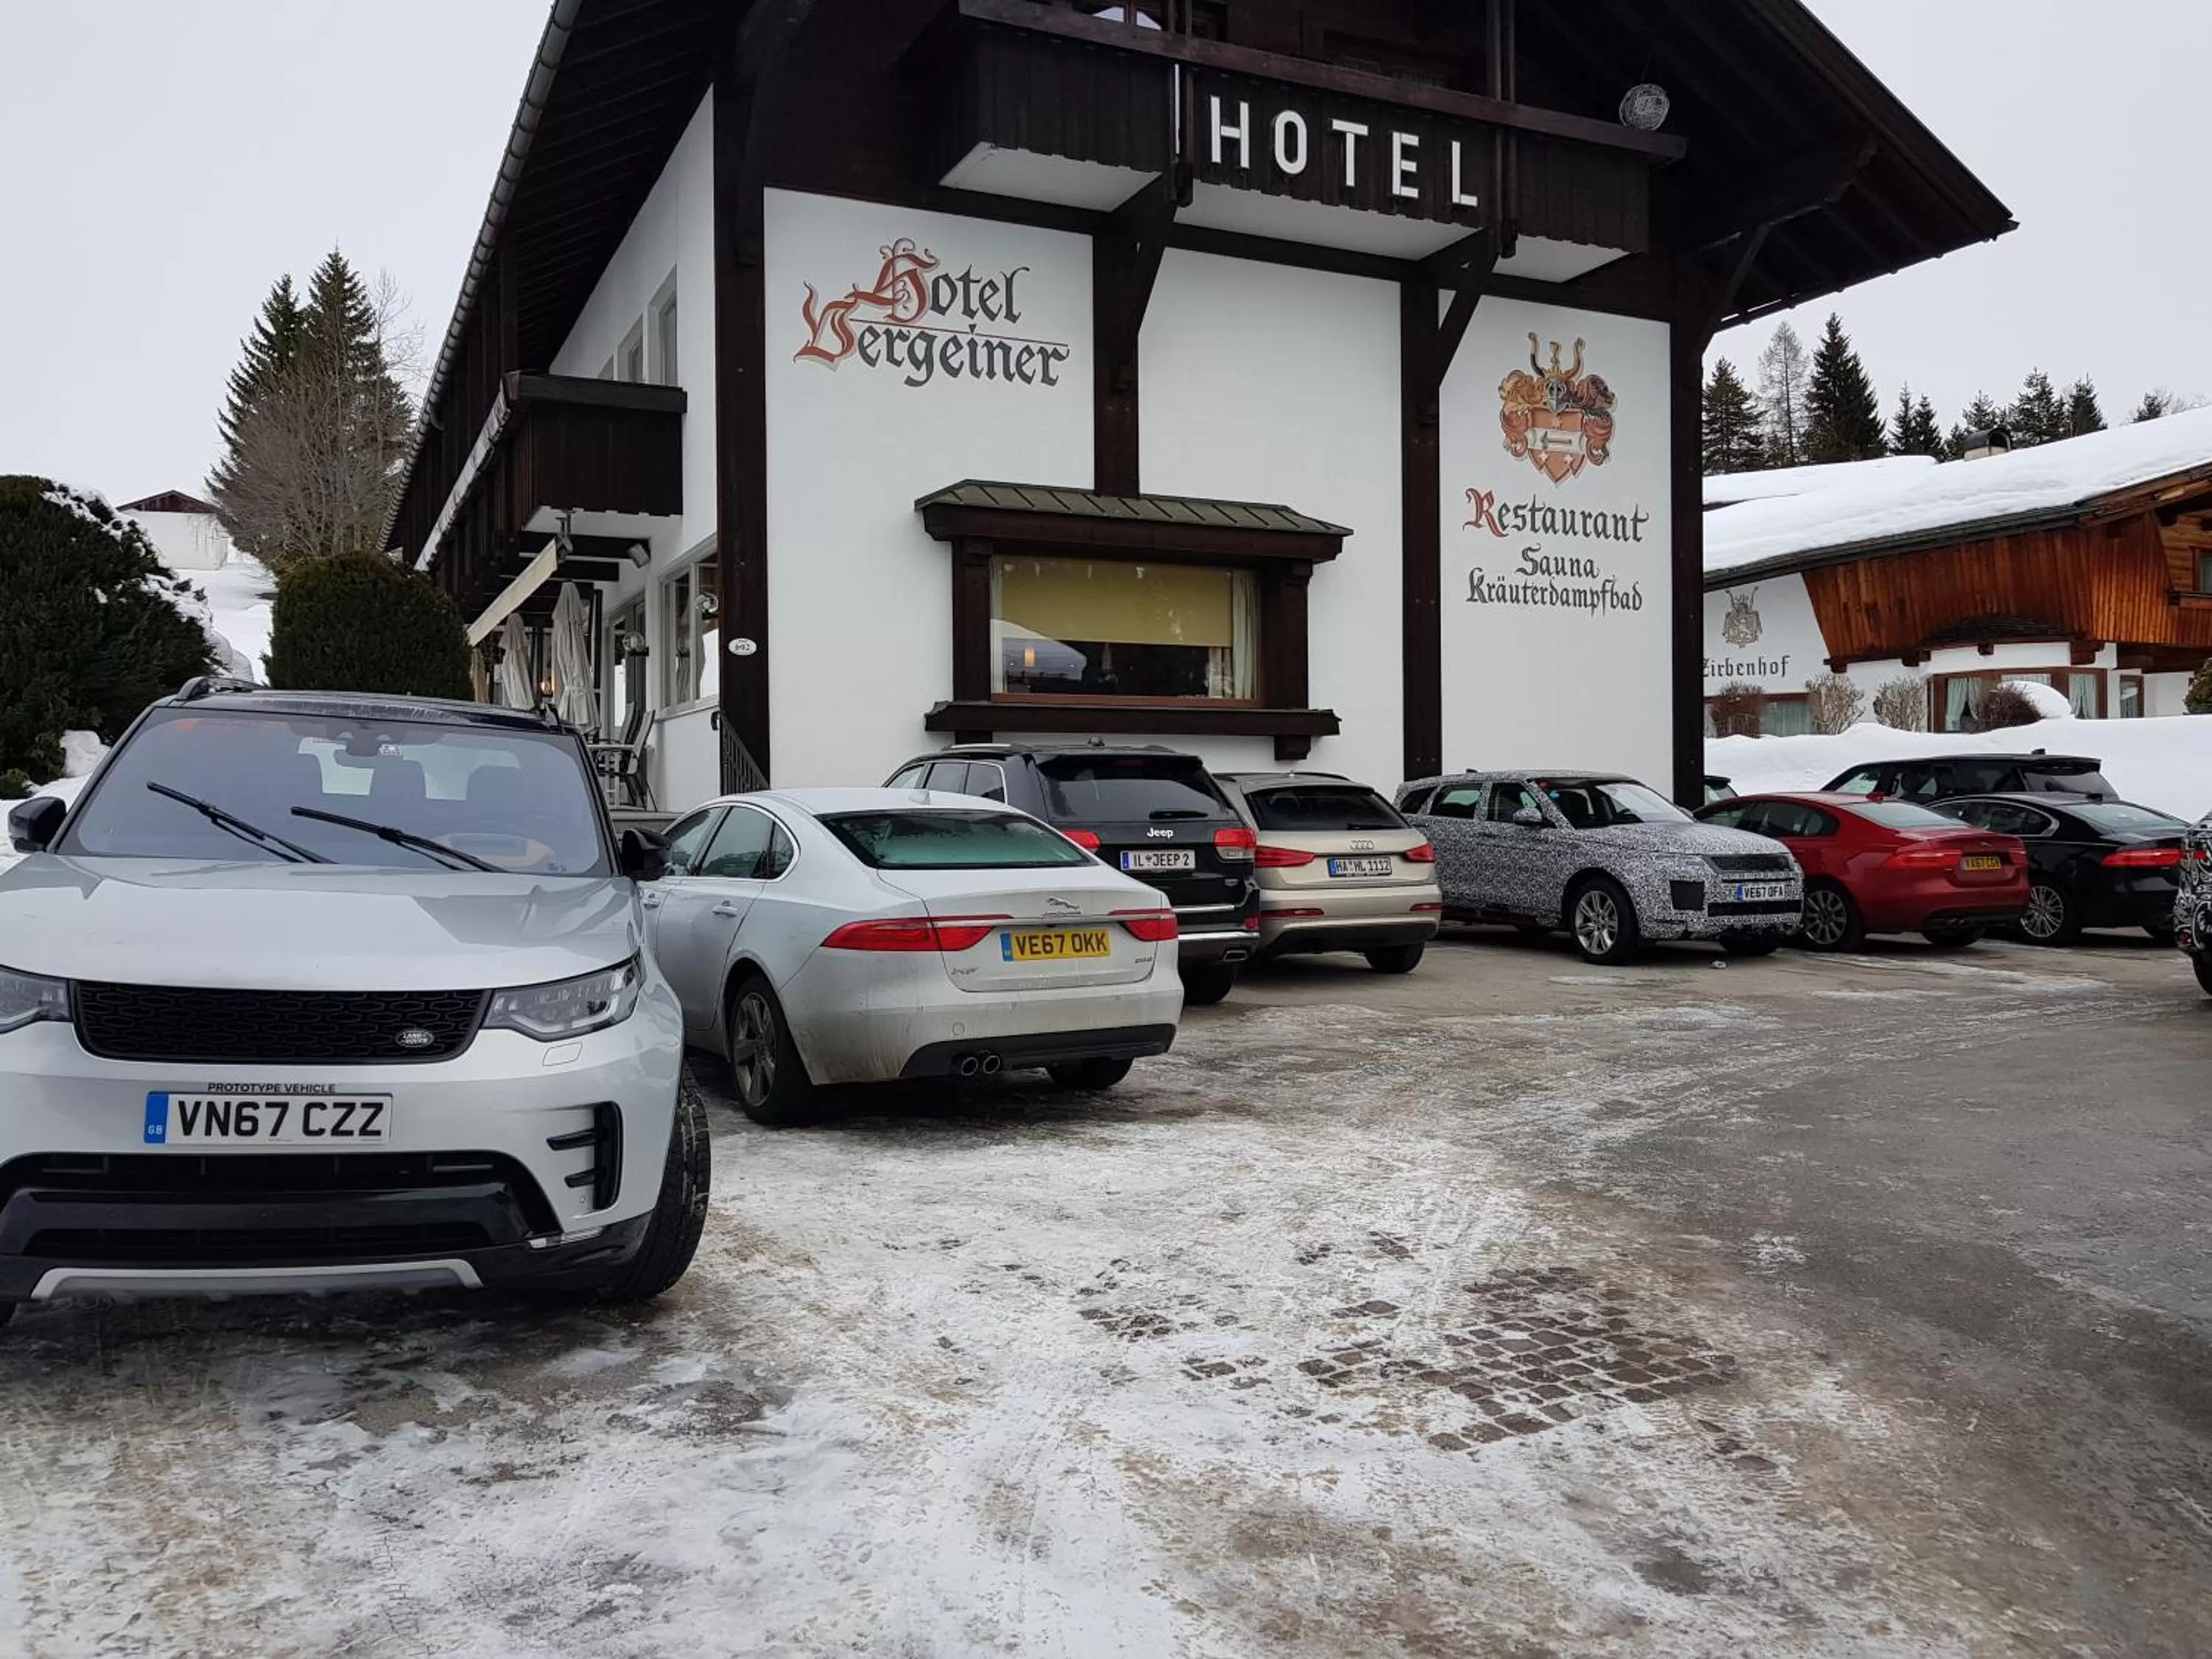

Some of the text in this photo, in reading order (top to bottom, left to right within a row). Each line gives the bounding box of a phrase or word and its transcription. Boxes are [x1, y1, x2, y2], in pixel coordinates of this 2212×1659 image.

[1210, 95, 1478, 207] HOTEL
[844, 237, 1030, 324] Hotel
[793, 280, 1070, 388] Vergeiner
[1463, 487, 1649, 543] Restaurant
[1515, 543, 1599, 578] Sauna
[1466, 567, 1643, 618] Kräuterdampfbad
[1147, 827, 1174, 838] Jeep
[1152, 853, 1180, 866] JEEP
[1182, 853, 1189, 866] 2
[1744, 886, 1766, 898] VE67
[1015, 932, 1107, 956] VE67 OKK
[207, 1082, 336, 1094] PROTOTYPE VEHICLE
[148, 1124, 163, 1135] GB
[178, 1100, 384, 1138] VN67 CZZ
